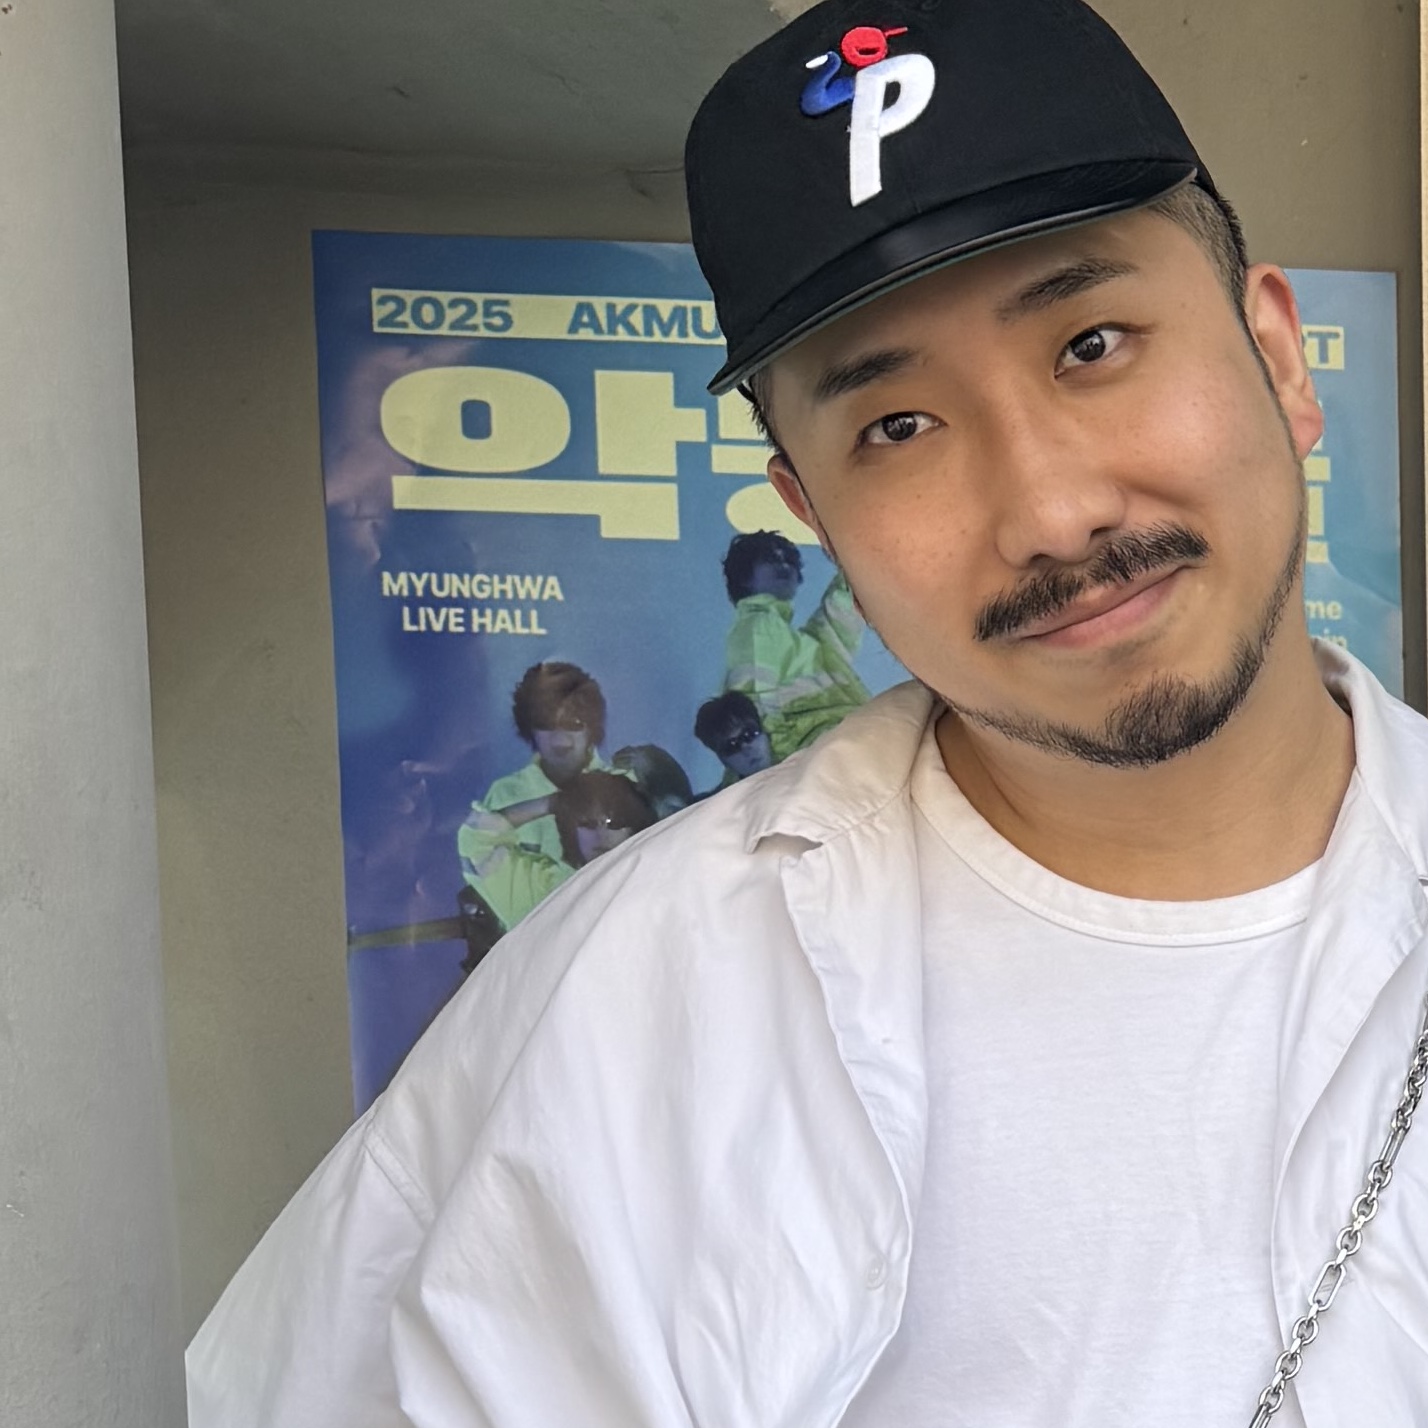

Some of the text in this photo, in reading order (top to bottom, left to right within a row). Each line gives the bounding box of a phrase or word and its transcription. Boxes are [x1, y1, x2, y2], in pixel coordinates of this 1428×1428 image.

[375, 295, 514, 331] 2025
[381, 571, 564, 601] MYUNGHWA
[402, 607, 547, 636] LIVE HALL
